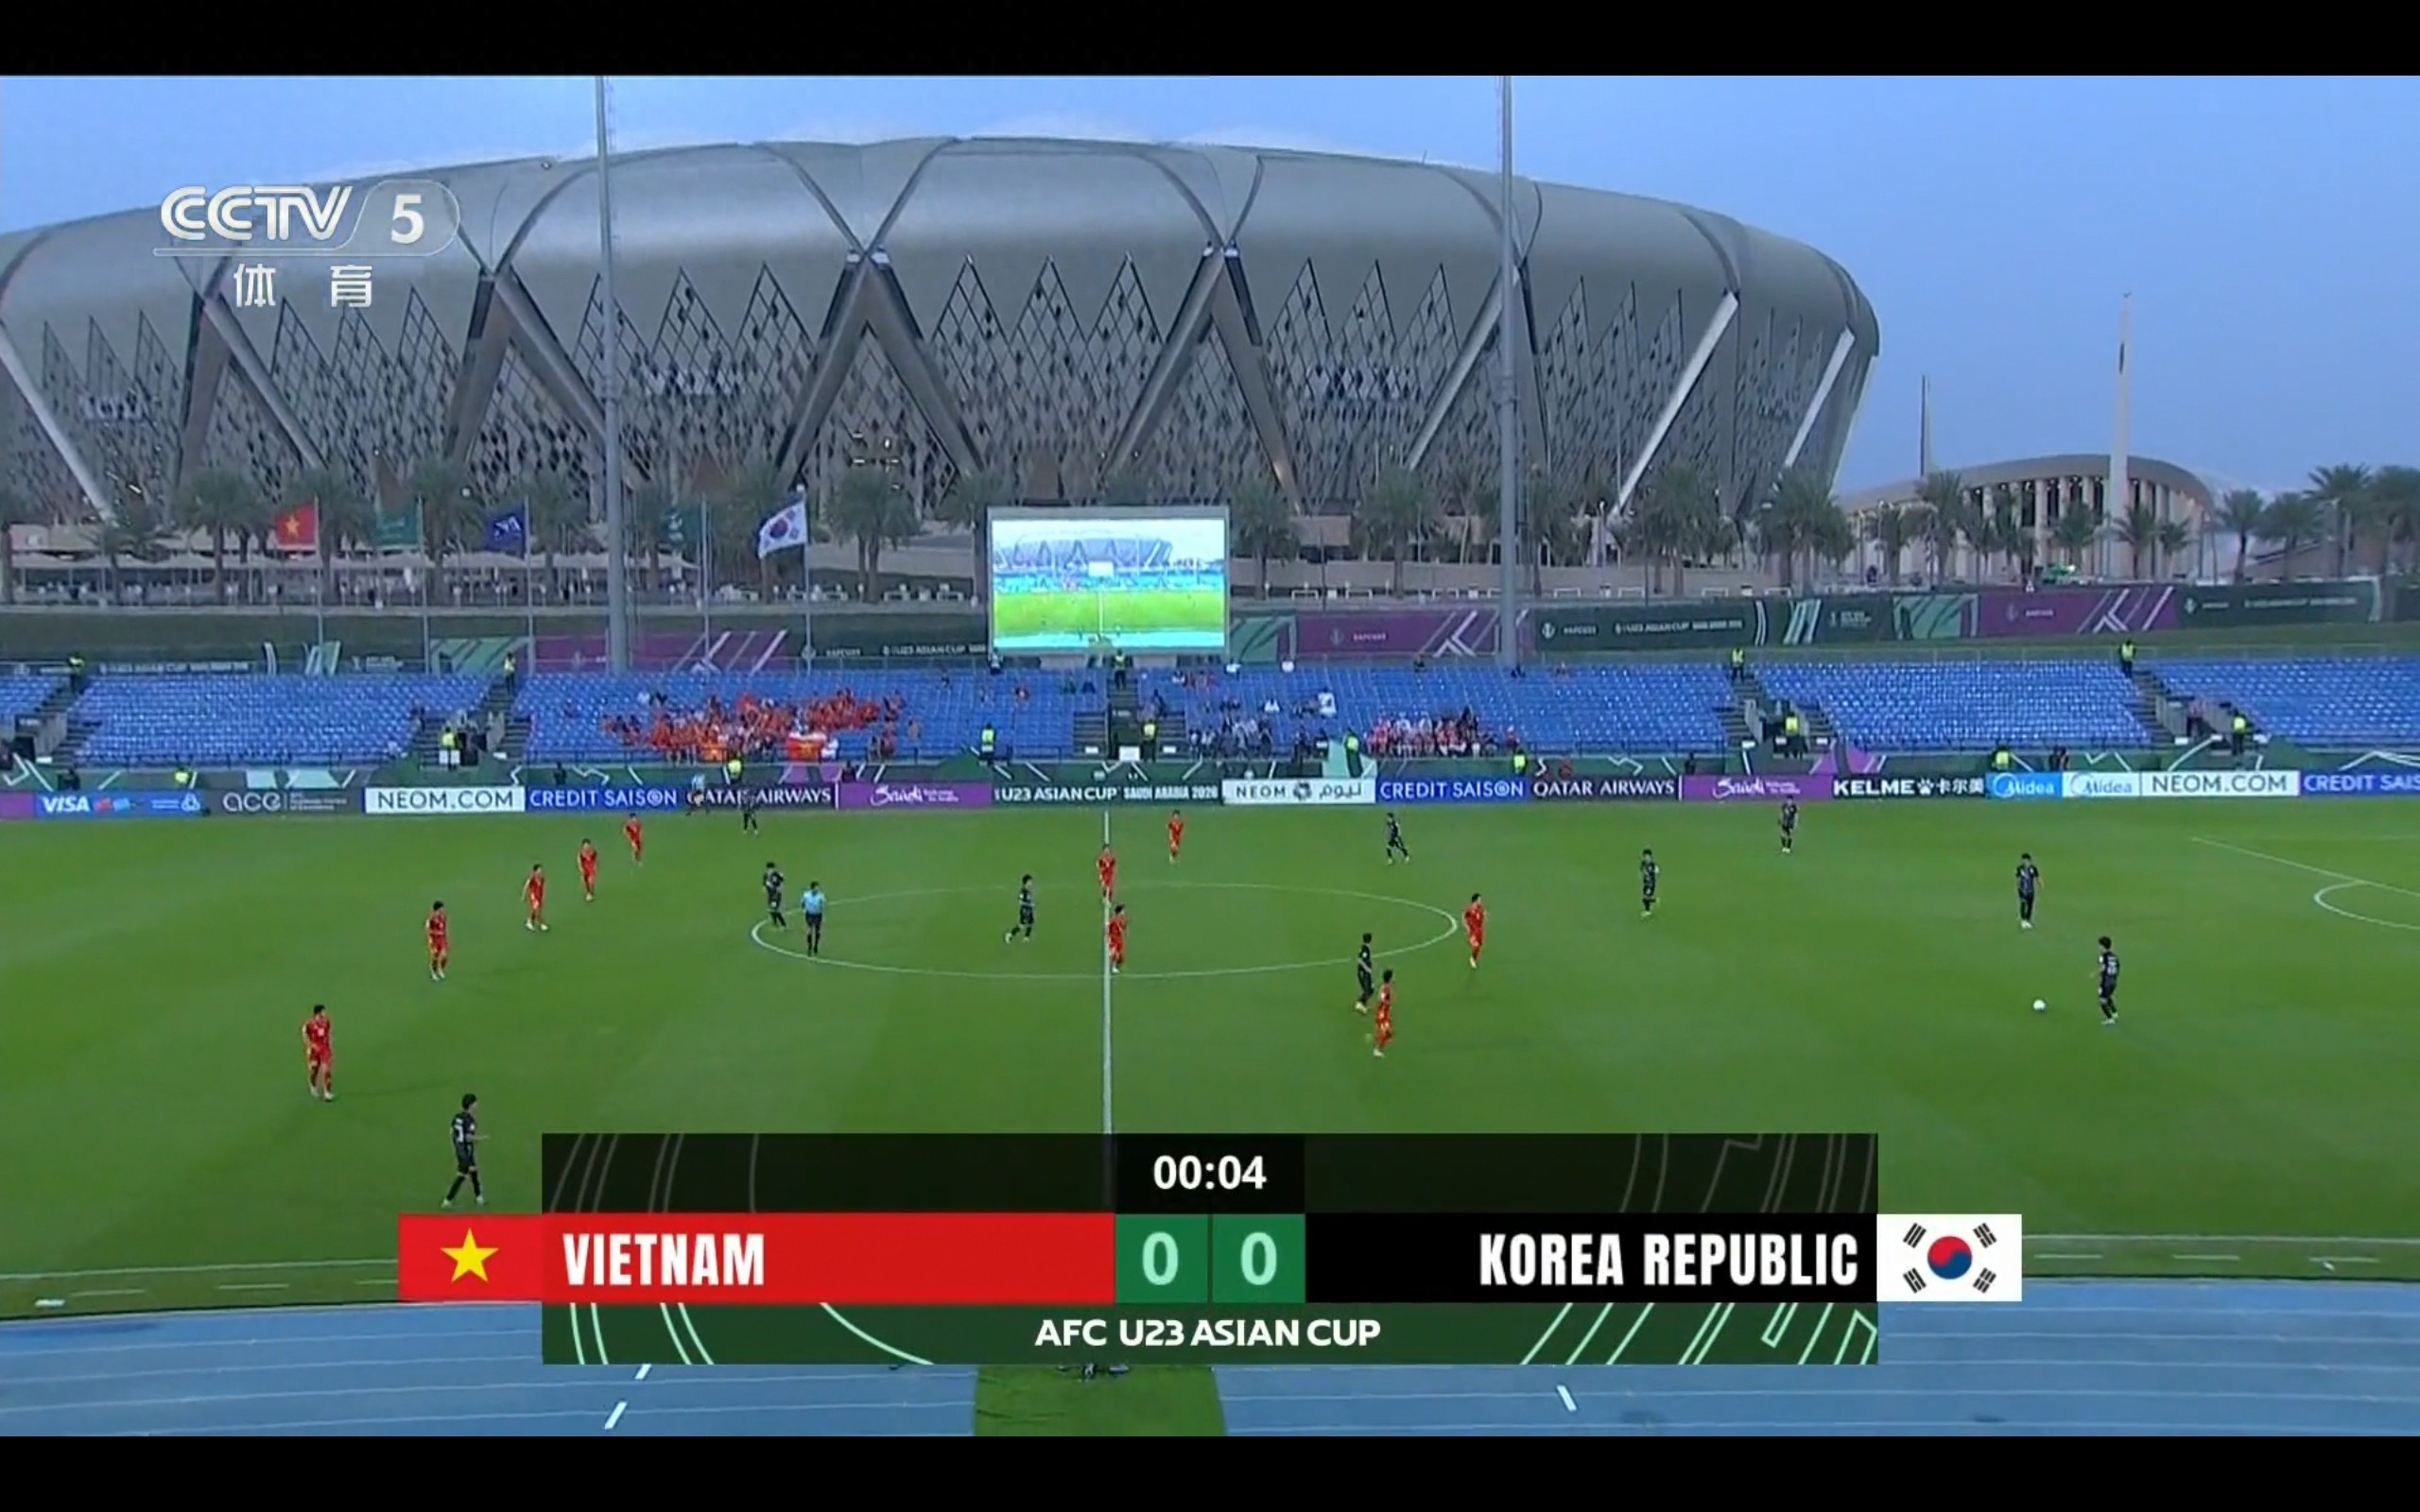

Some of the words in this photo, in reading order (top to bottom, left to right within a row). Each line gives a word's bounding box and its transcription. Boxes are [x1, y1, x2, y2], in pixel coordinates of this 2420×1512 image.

[1236, 784, 1287, 799] NEOM
[1379, 781, 1448, 799] CREDIT
[1452, 780, 1525, 799] SAISON
[1532, 780, 1593, 798] QATAR
[1599, 779, 1675, 796] AIRWAYS
[1833, 779, 1916, 797] KELME
[2005, 779, 2055, 796] Midea
[2083, 777, 2133, 795] Midea
[2152, 773, 2288, 793] NEOM.COM
[2303, 774, 2376, 792] CREDIT
[222, 791, 282, 813] ace
[378, 789, 513, 810] NEOM.COM
[529, 789, 599, 808] CREDIT
[603, 788, 678, 807] SAISON
[755, 786, 832, 805] AIRWAYS
[1001, 786, 1032, 802] U23
[1033, 786, 1082, 801] ASIAN
[1083, 786, 1118, 801] CUP
[40, 795, 92, 813] VISA
